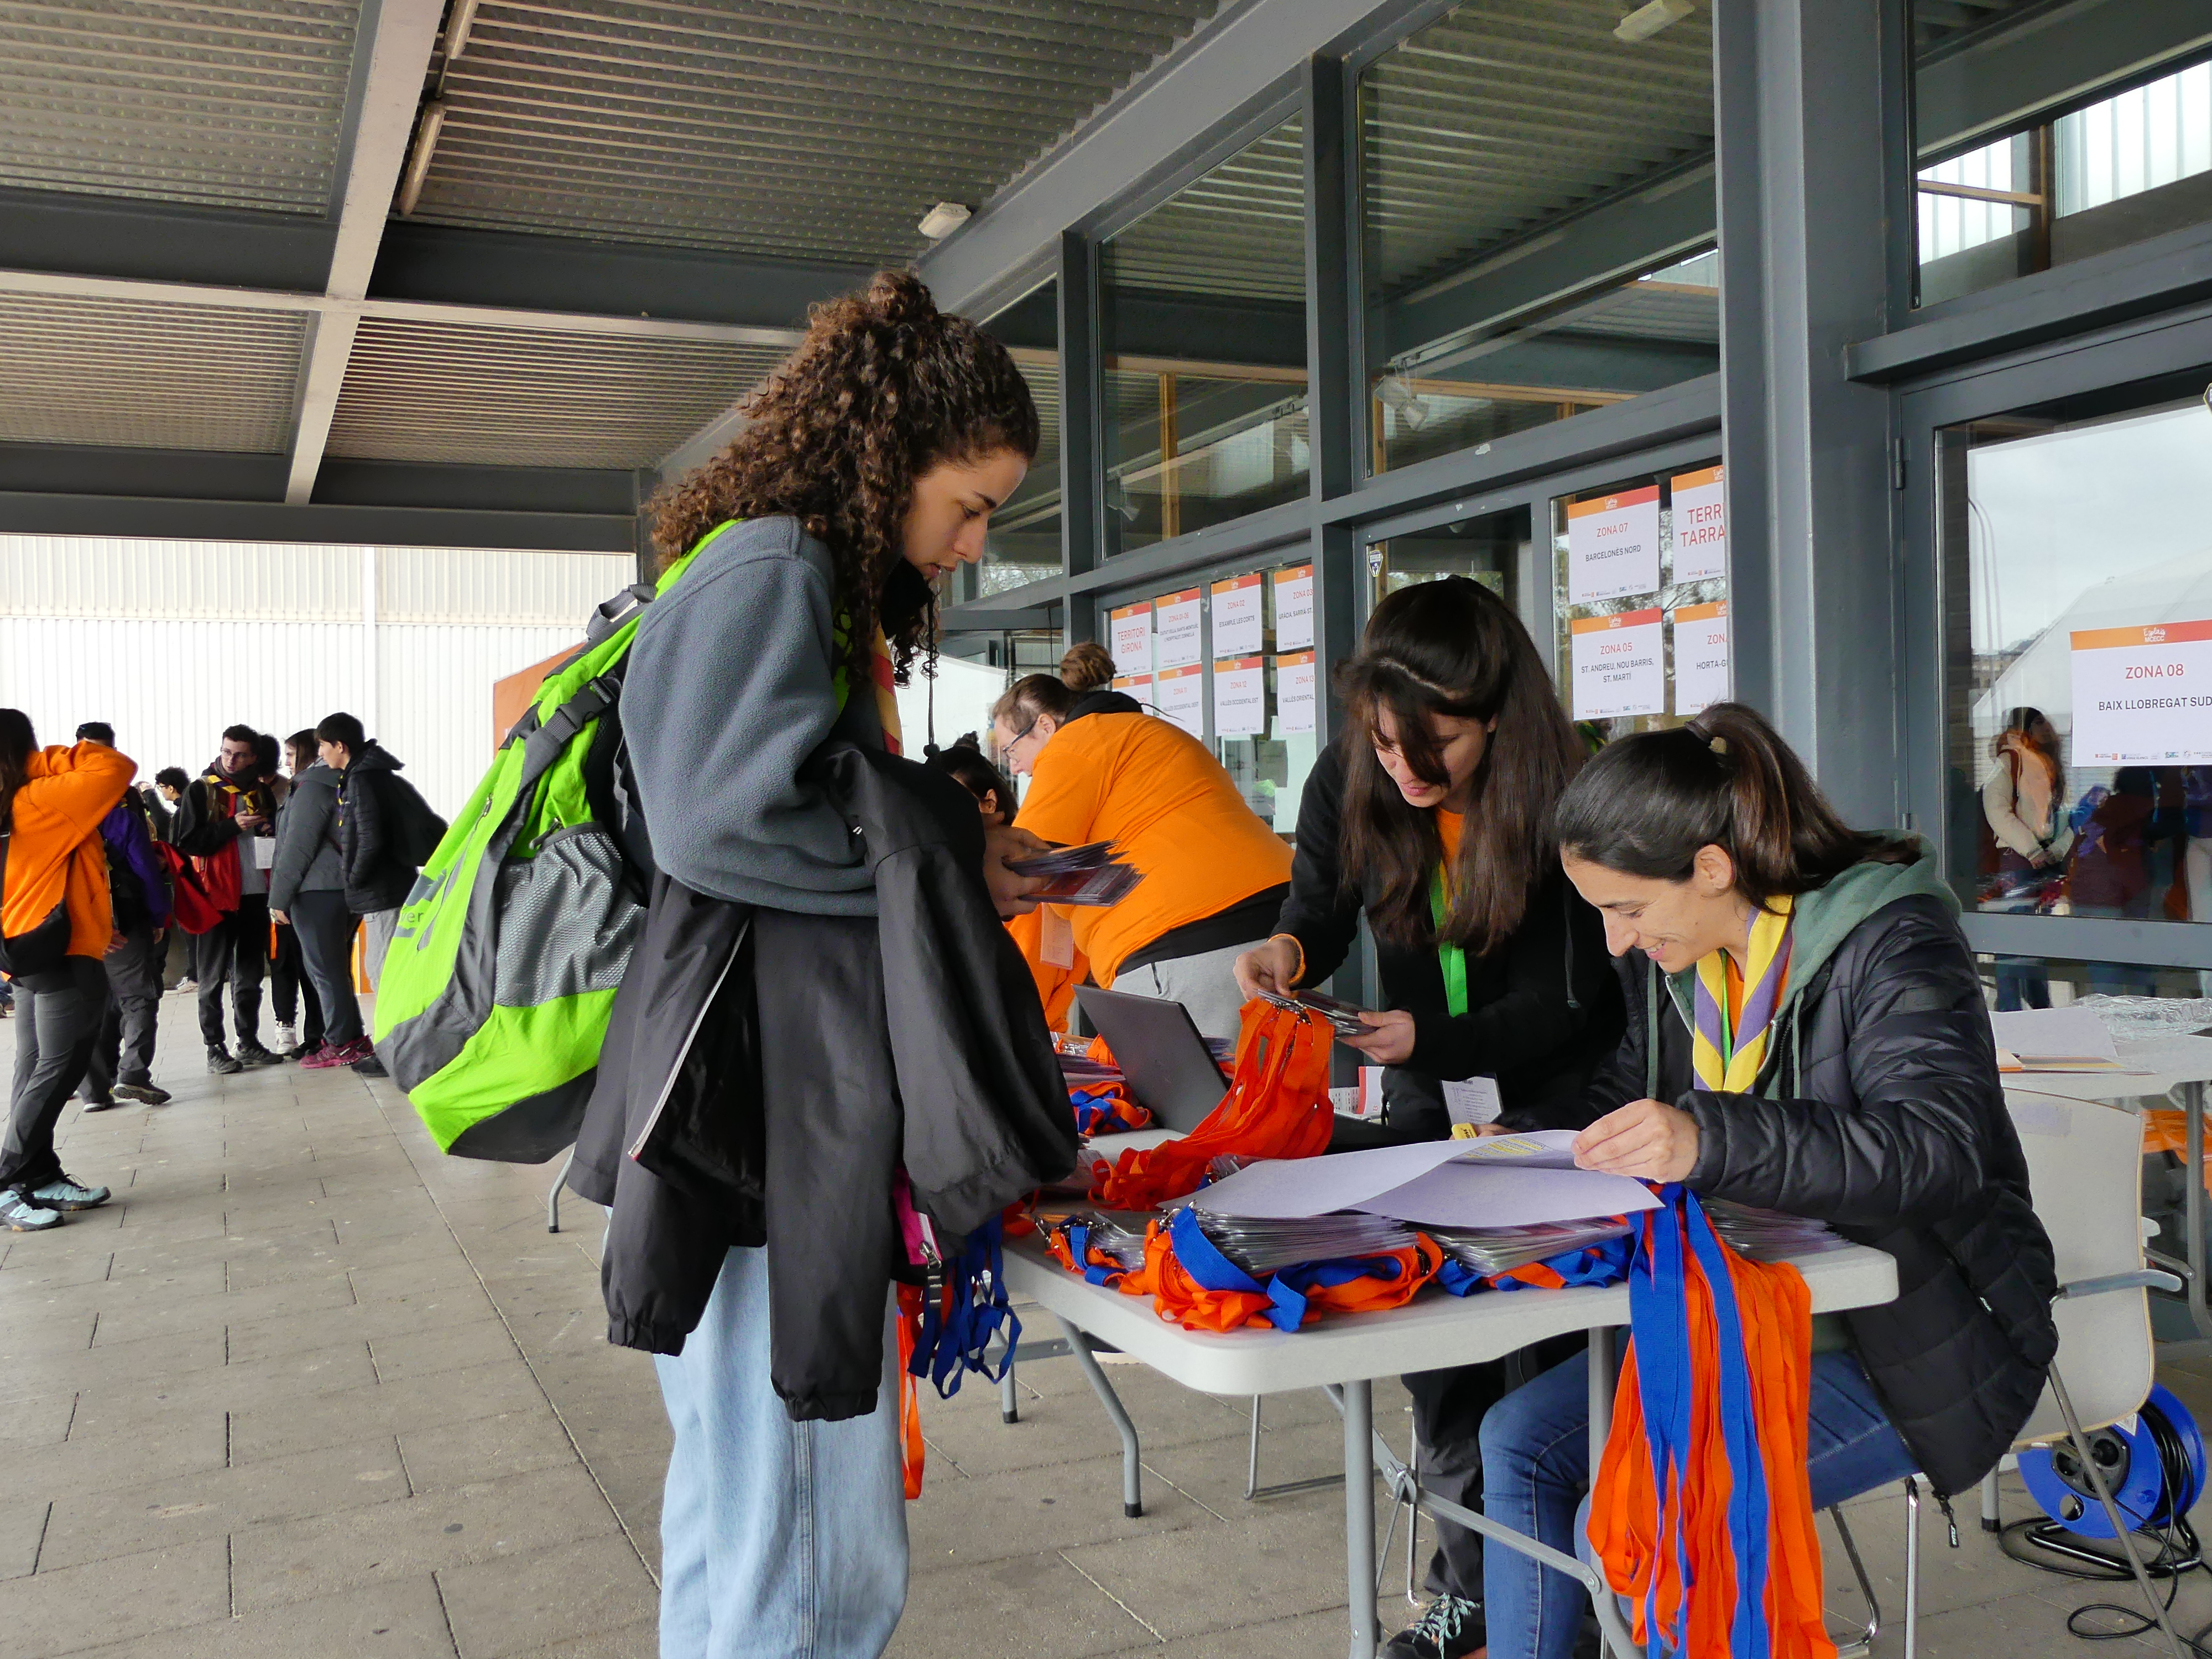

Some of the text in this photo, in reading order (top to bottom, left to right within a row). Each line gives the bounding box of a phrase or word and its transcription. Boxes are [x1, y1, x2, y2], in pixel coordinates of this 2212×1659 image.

[1687, 503, 1724, 525] TERR
[1597, 523, 1628, 538] ZONA 07
[1680, 524, 1726, 547] TARRA
[1585, 545, 1641, 562] BARCELONÈS NORD
[1293, 588, 1313, 599] ZONA 03
[1227, 601, 1239, 609] ZONA
[1118, 627, 1146, 641] TERRITORI
[1707, 633, 1728, 645] ZON
[1121, 641, 1142, 654] GIRONA
[1600, 642, 1632, 655] ZONA 05
[1590, 663, 1616, 672] ANDREU,
[1616, 661, 1629, 669] NOU
[1631, 658, 1654, 667] BARRIS,
[2125, 663, 2184, 679] ZONA 08
[1296, 676, 1309, 685] ZONA
[1613, 671, 1631, 682] MARTÍ
[1230, 681, 1241, 690] ZONA
[2099, 696, 2212, 711] BAIX LLOBREGAT SUD
